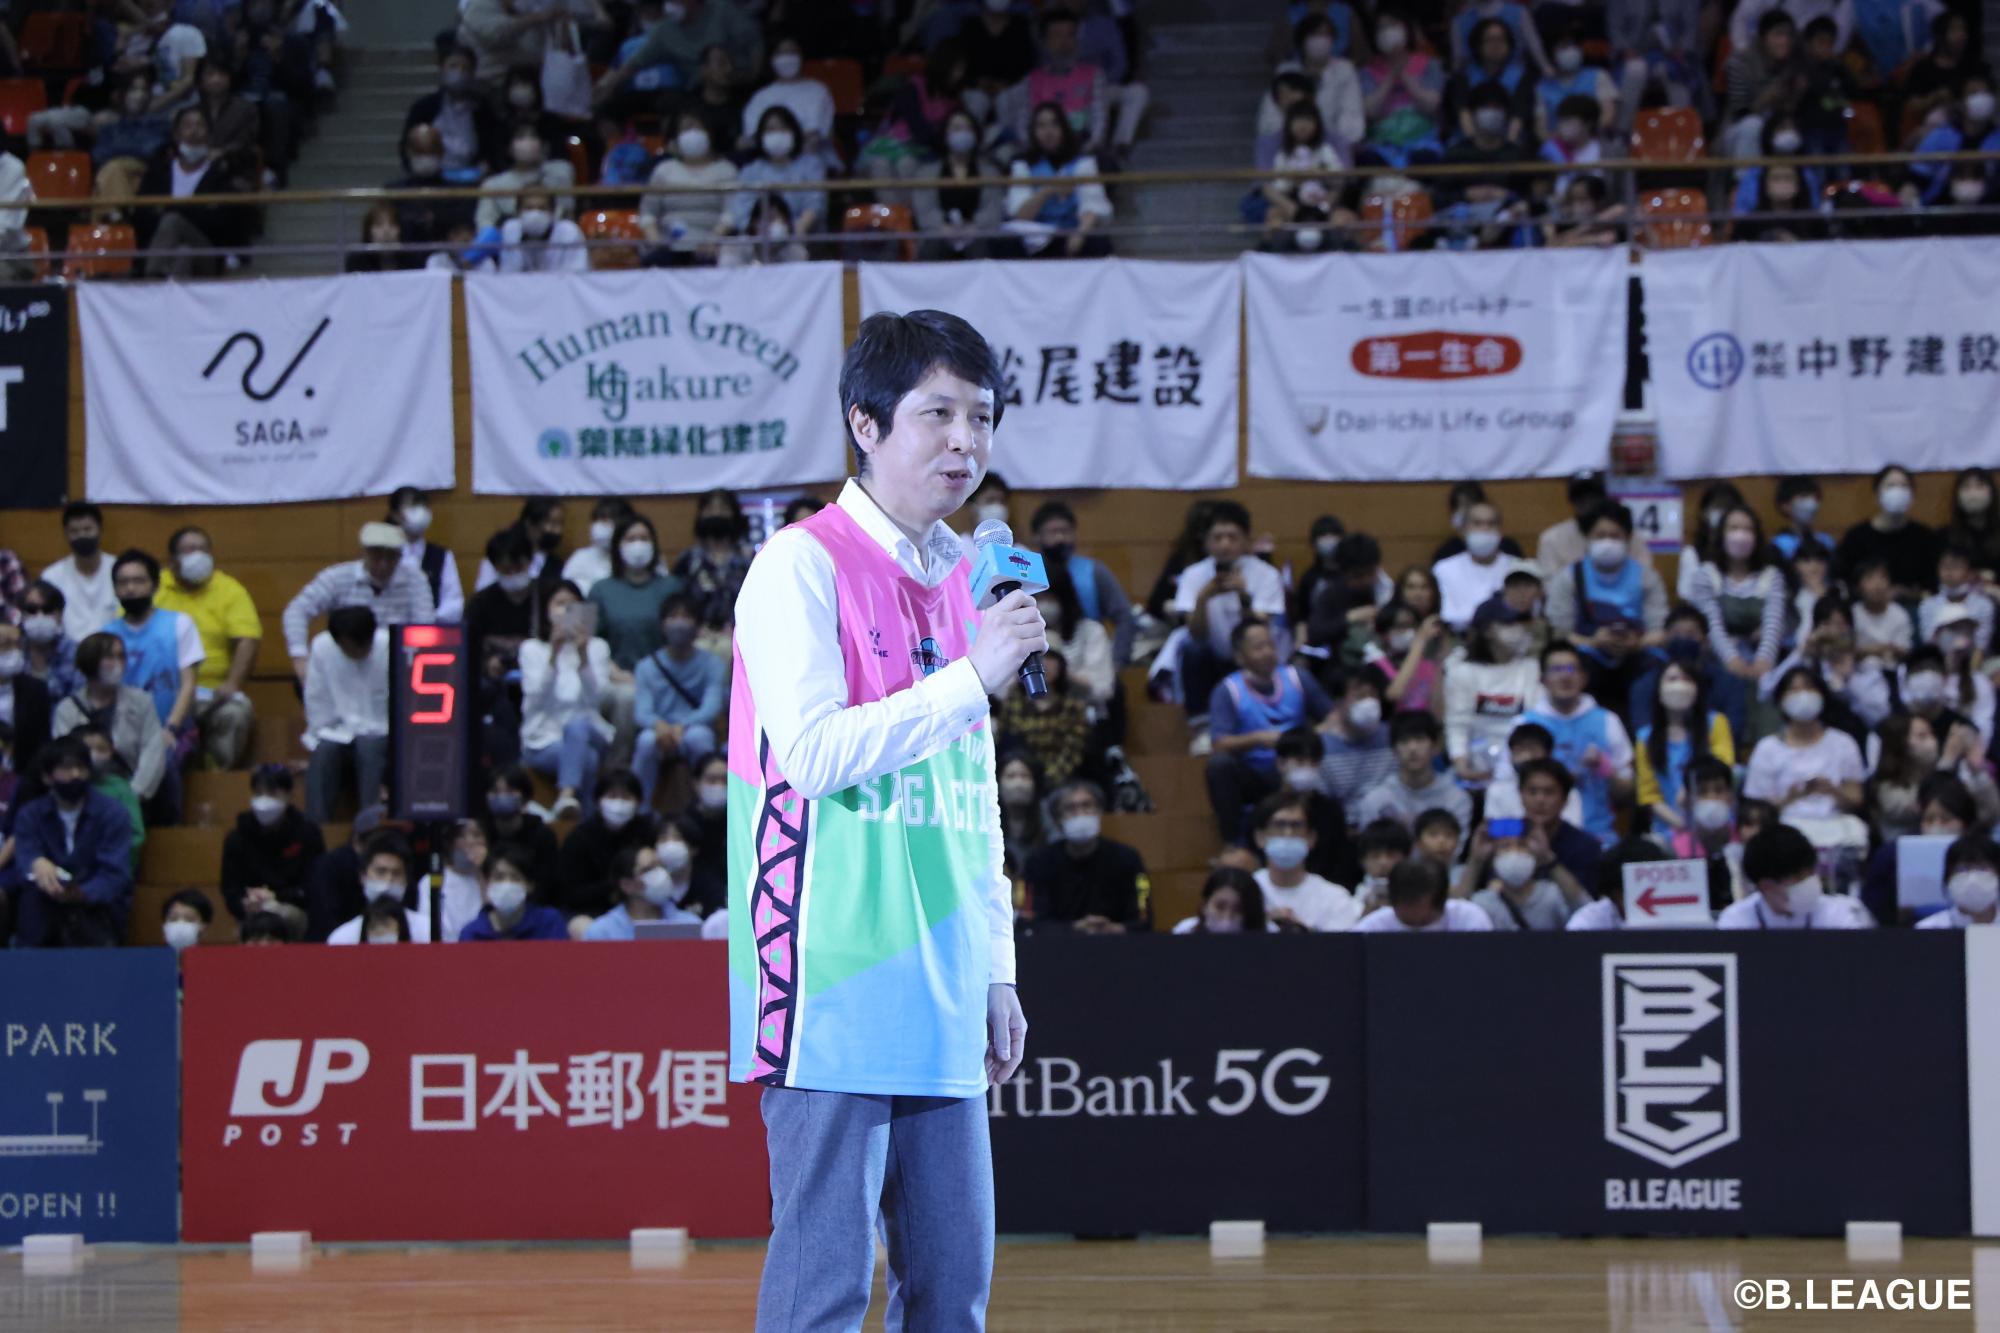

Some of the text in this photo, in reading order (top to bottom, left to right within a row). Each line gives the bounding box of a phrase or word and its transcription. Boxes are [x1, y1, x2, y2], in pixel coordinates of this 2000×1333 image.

[518, 301, 800, 384] Human Green
[1366, 338, 1506, 375] 第一生命
[234, 419, 304, 446] SAGA
[1441, 408, 1488, 431] Life
[1498, 407, 1576, 431] Group
[1636, 503, 1660, 534] 4
[410, 654, 456, 723] 5
[6, 1023, 117, 1056] PARK
[410, 1048, 730, 1131] 日本郵便
[1207, 1048, 1331, 1116] 5G
[222, 1122, 358, 1147] POST
[0, 1193, 82, 1218] OPEN
[1605, 1178, 1741, 1210] B.LEAGUE
